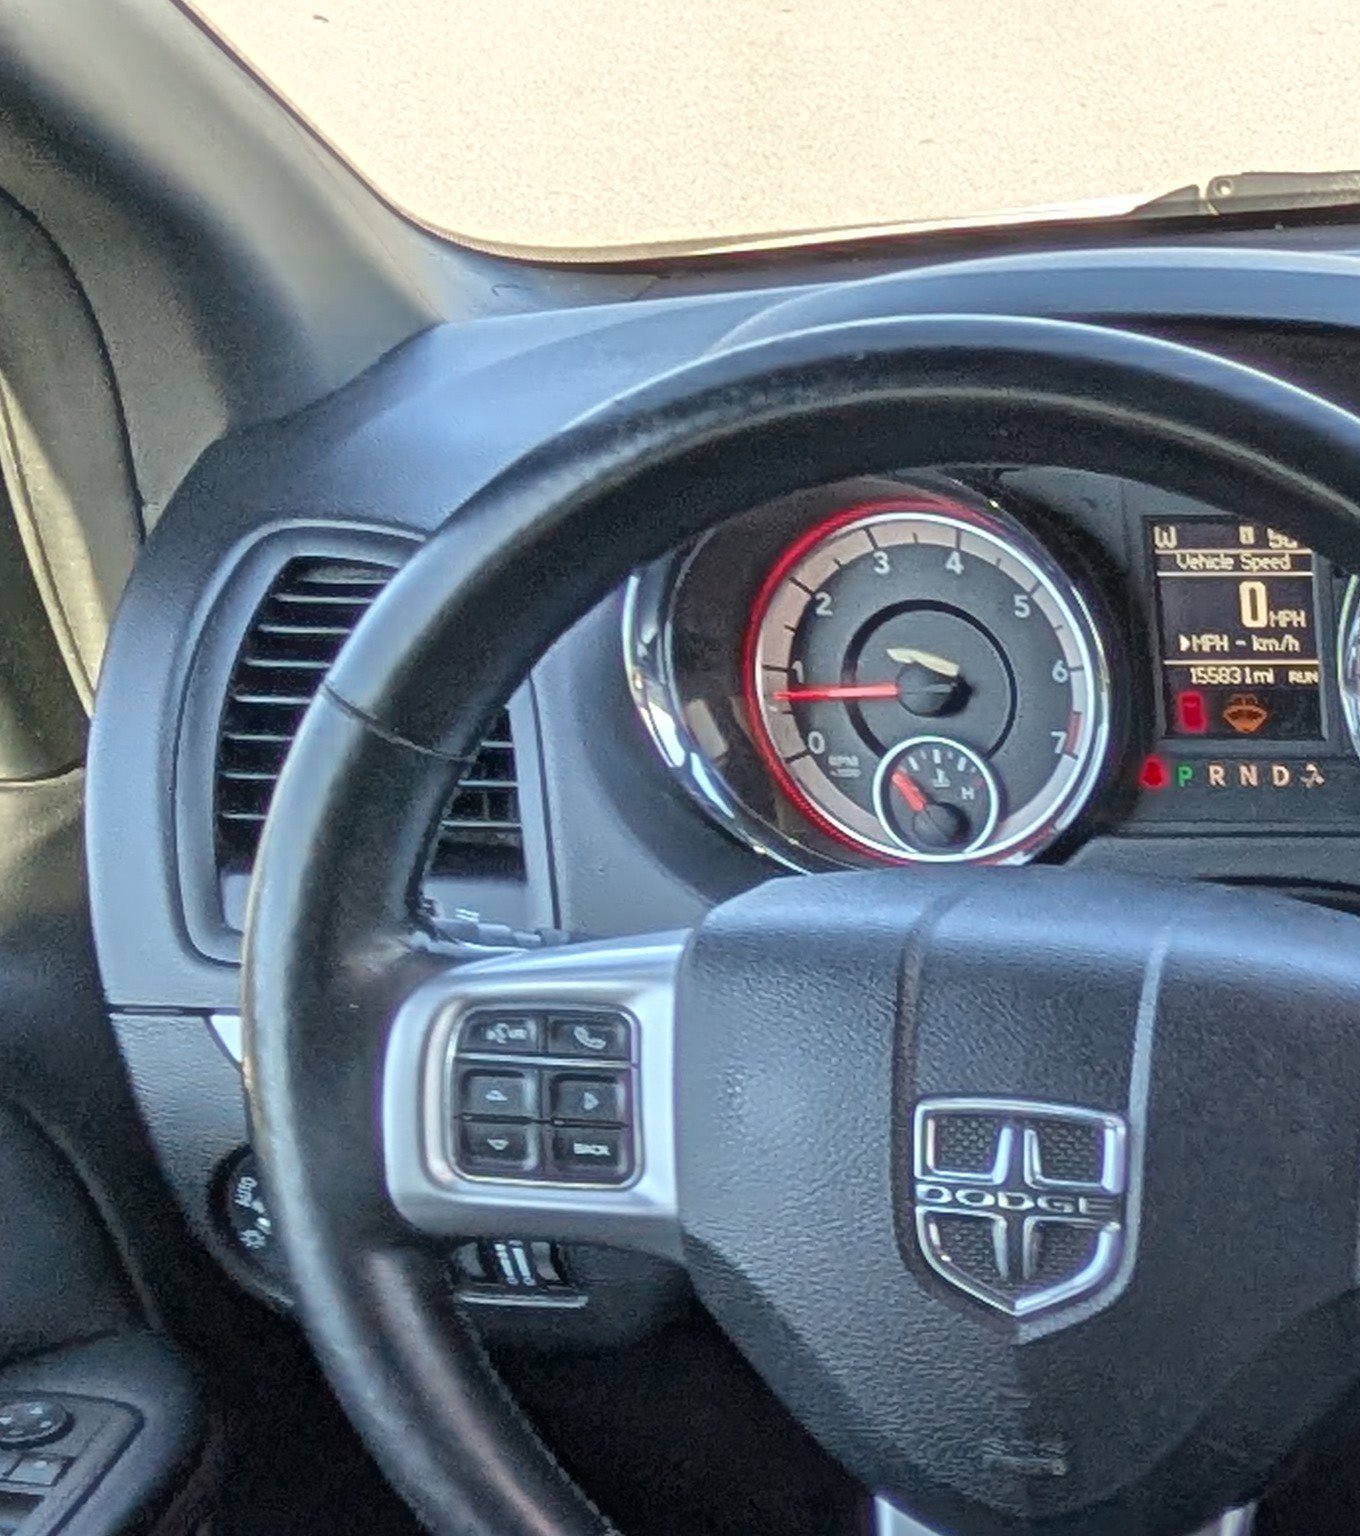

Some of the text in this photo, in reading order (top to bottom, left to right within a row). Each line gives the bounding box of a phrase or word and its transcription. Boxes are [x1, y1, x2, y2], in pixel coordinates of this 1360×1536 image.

[873, 552, 892, 575] 3
[945, 553, 965, 576] 4
[1176, 552, 1292, 571] Vehicle Speed
[814, 594, 834, 617] 2
[1013, 595, 1032, 618] 5
[1238, 580, 1307, 628] 0 MPH
[1192, 634, 1229, 652] MPH
[1251, 633, 1302, 653] km/h
[792, 662, 804, 684] 1
[1051, 660, 1069, 683] 6
[808, 731, 825, 754] 0
[1050, 730, 1067, 753] 7
[1176, 764, 1291, 787] P R N D
[961, 785, 976, 800] H
[915, 1183, 1116, 1214] DODGE
